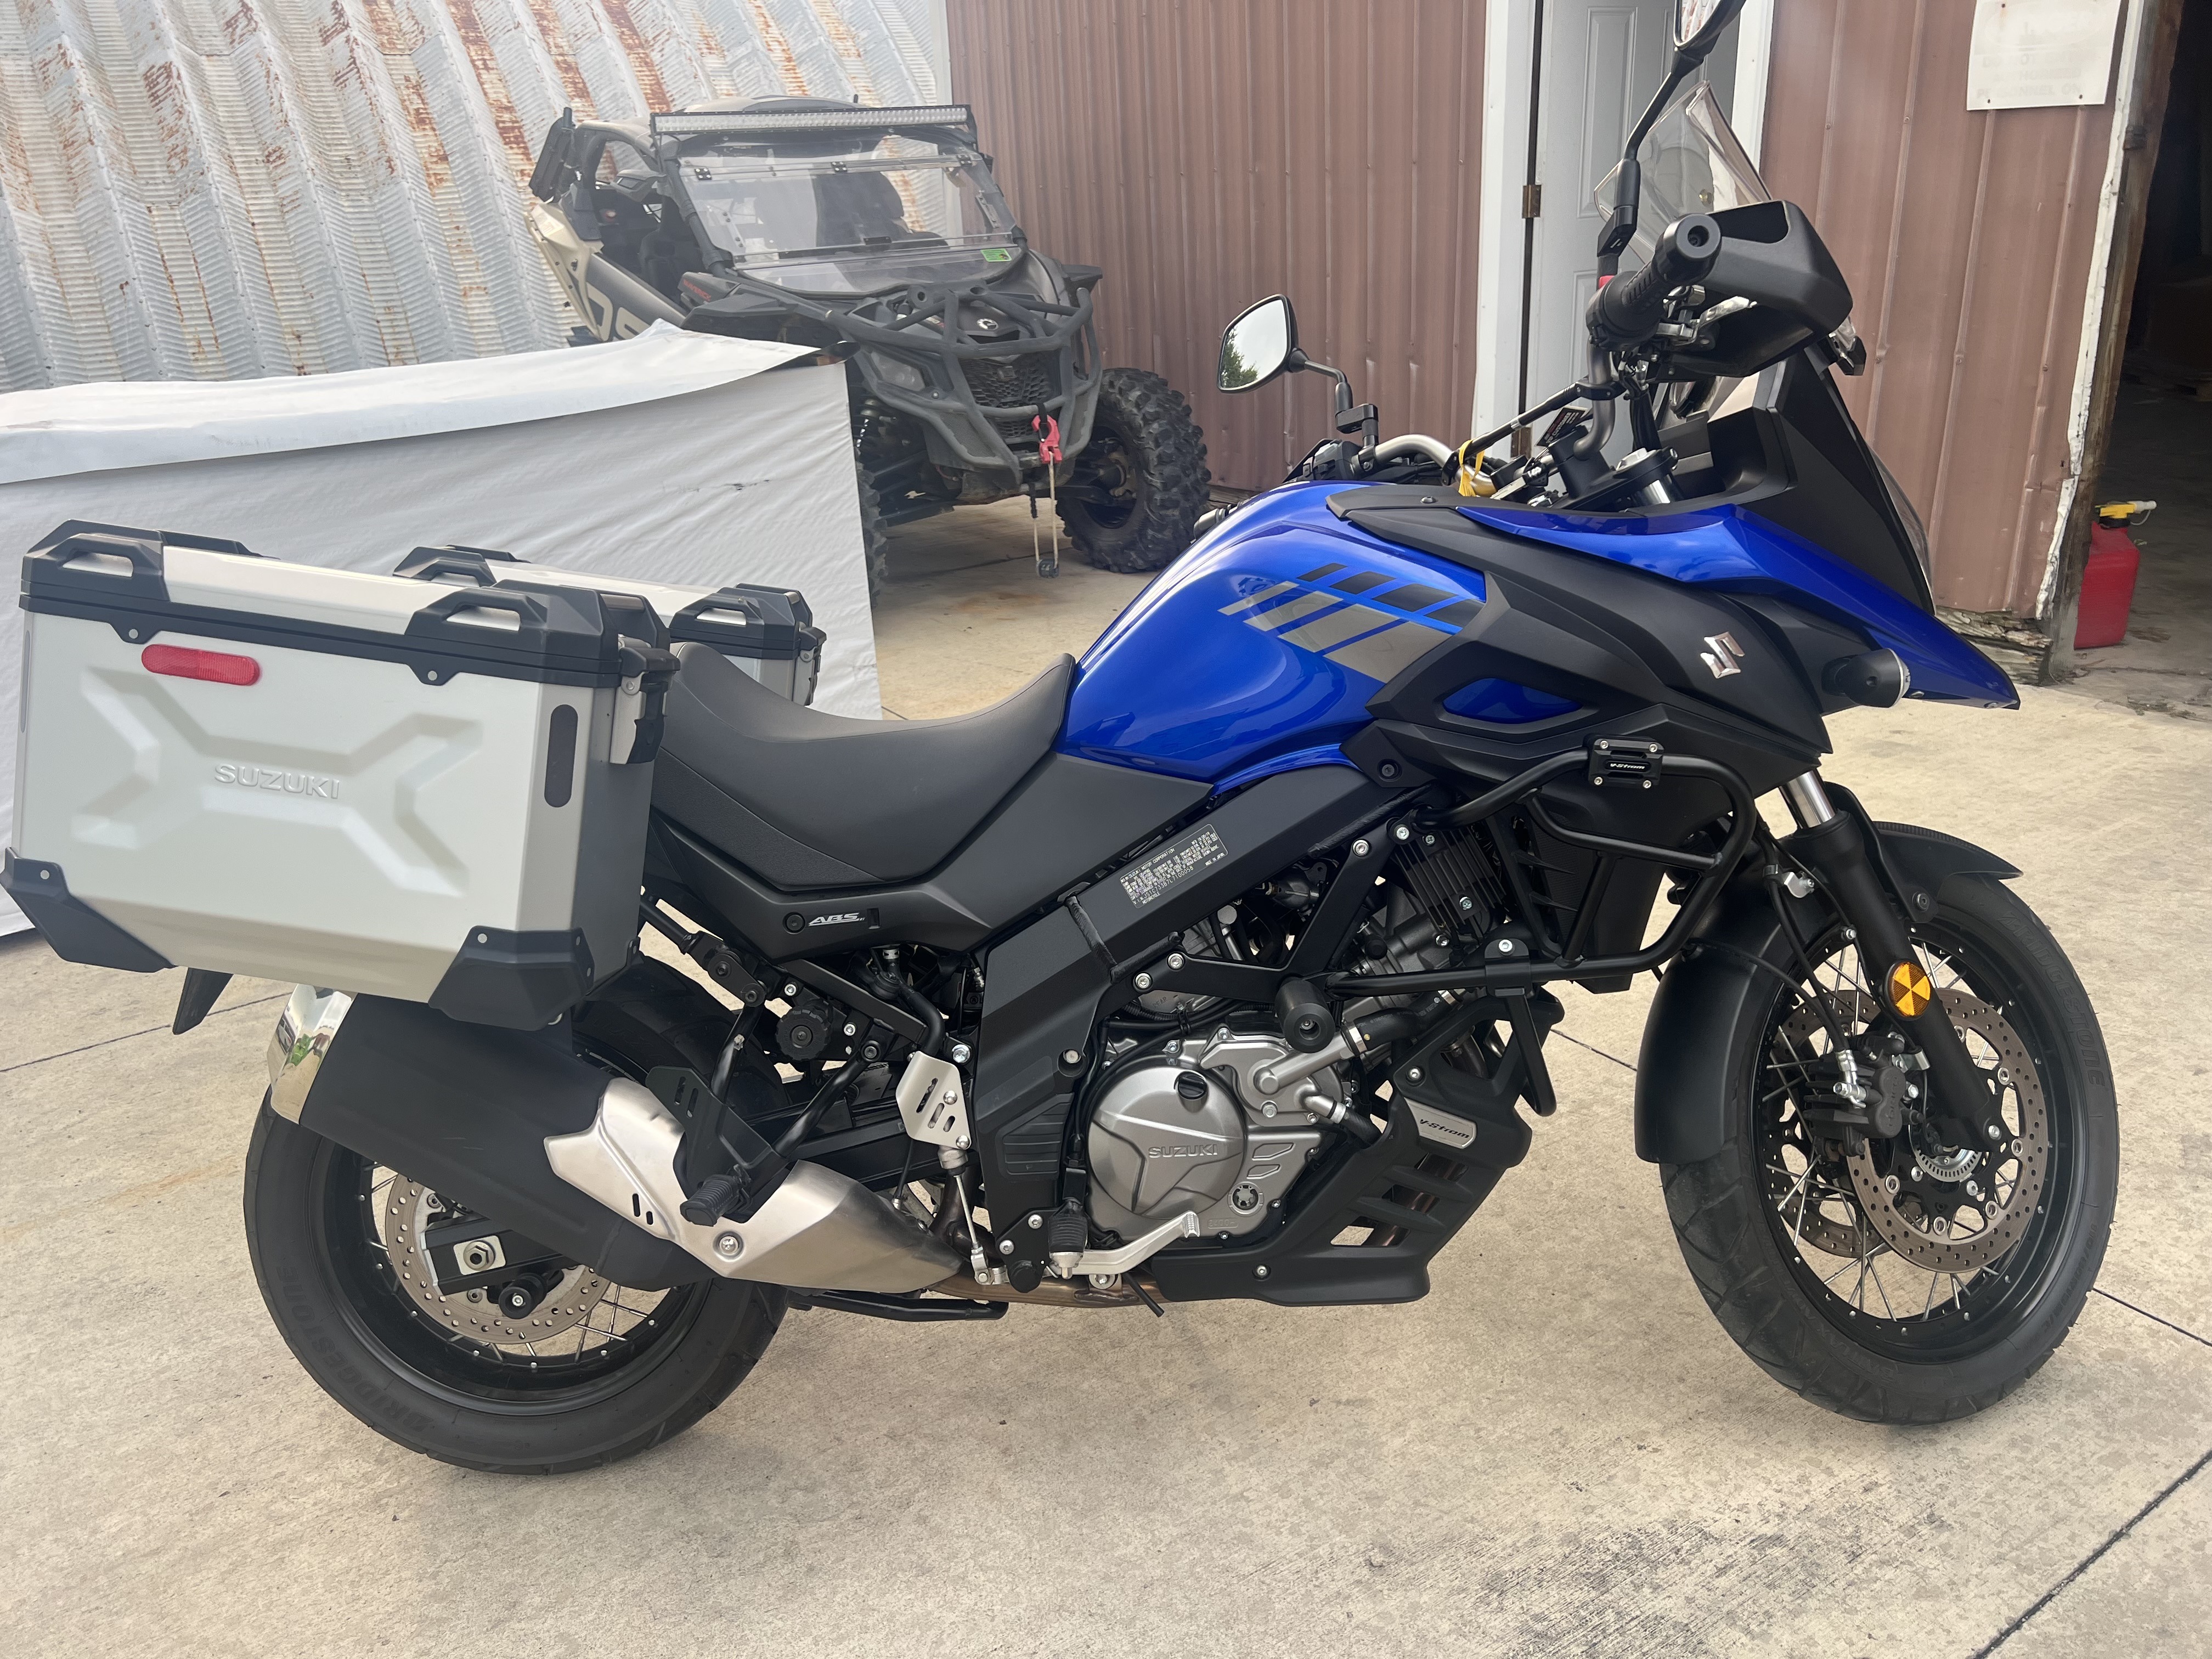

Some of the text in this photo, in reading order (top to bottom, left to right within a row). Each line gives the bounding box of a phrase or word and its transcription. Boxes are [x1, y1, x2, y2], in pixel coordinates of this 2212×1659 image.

[214, 763, 340, 799] SUZUKI
[809, 912, 860, 926] ABS
[1997, 910, 2106, 1087] BRIDGESTONE
[1419, 1118, 1471, 1139] V-Strom
[1148, 1144, 1218, 1159] SUZUKI
[276, 1264, 435, 1432] BRIDGESTONE
